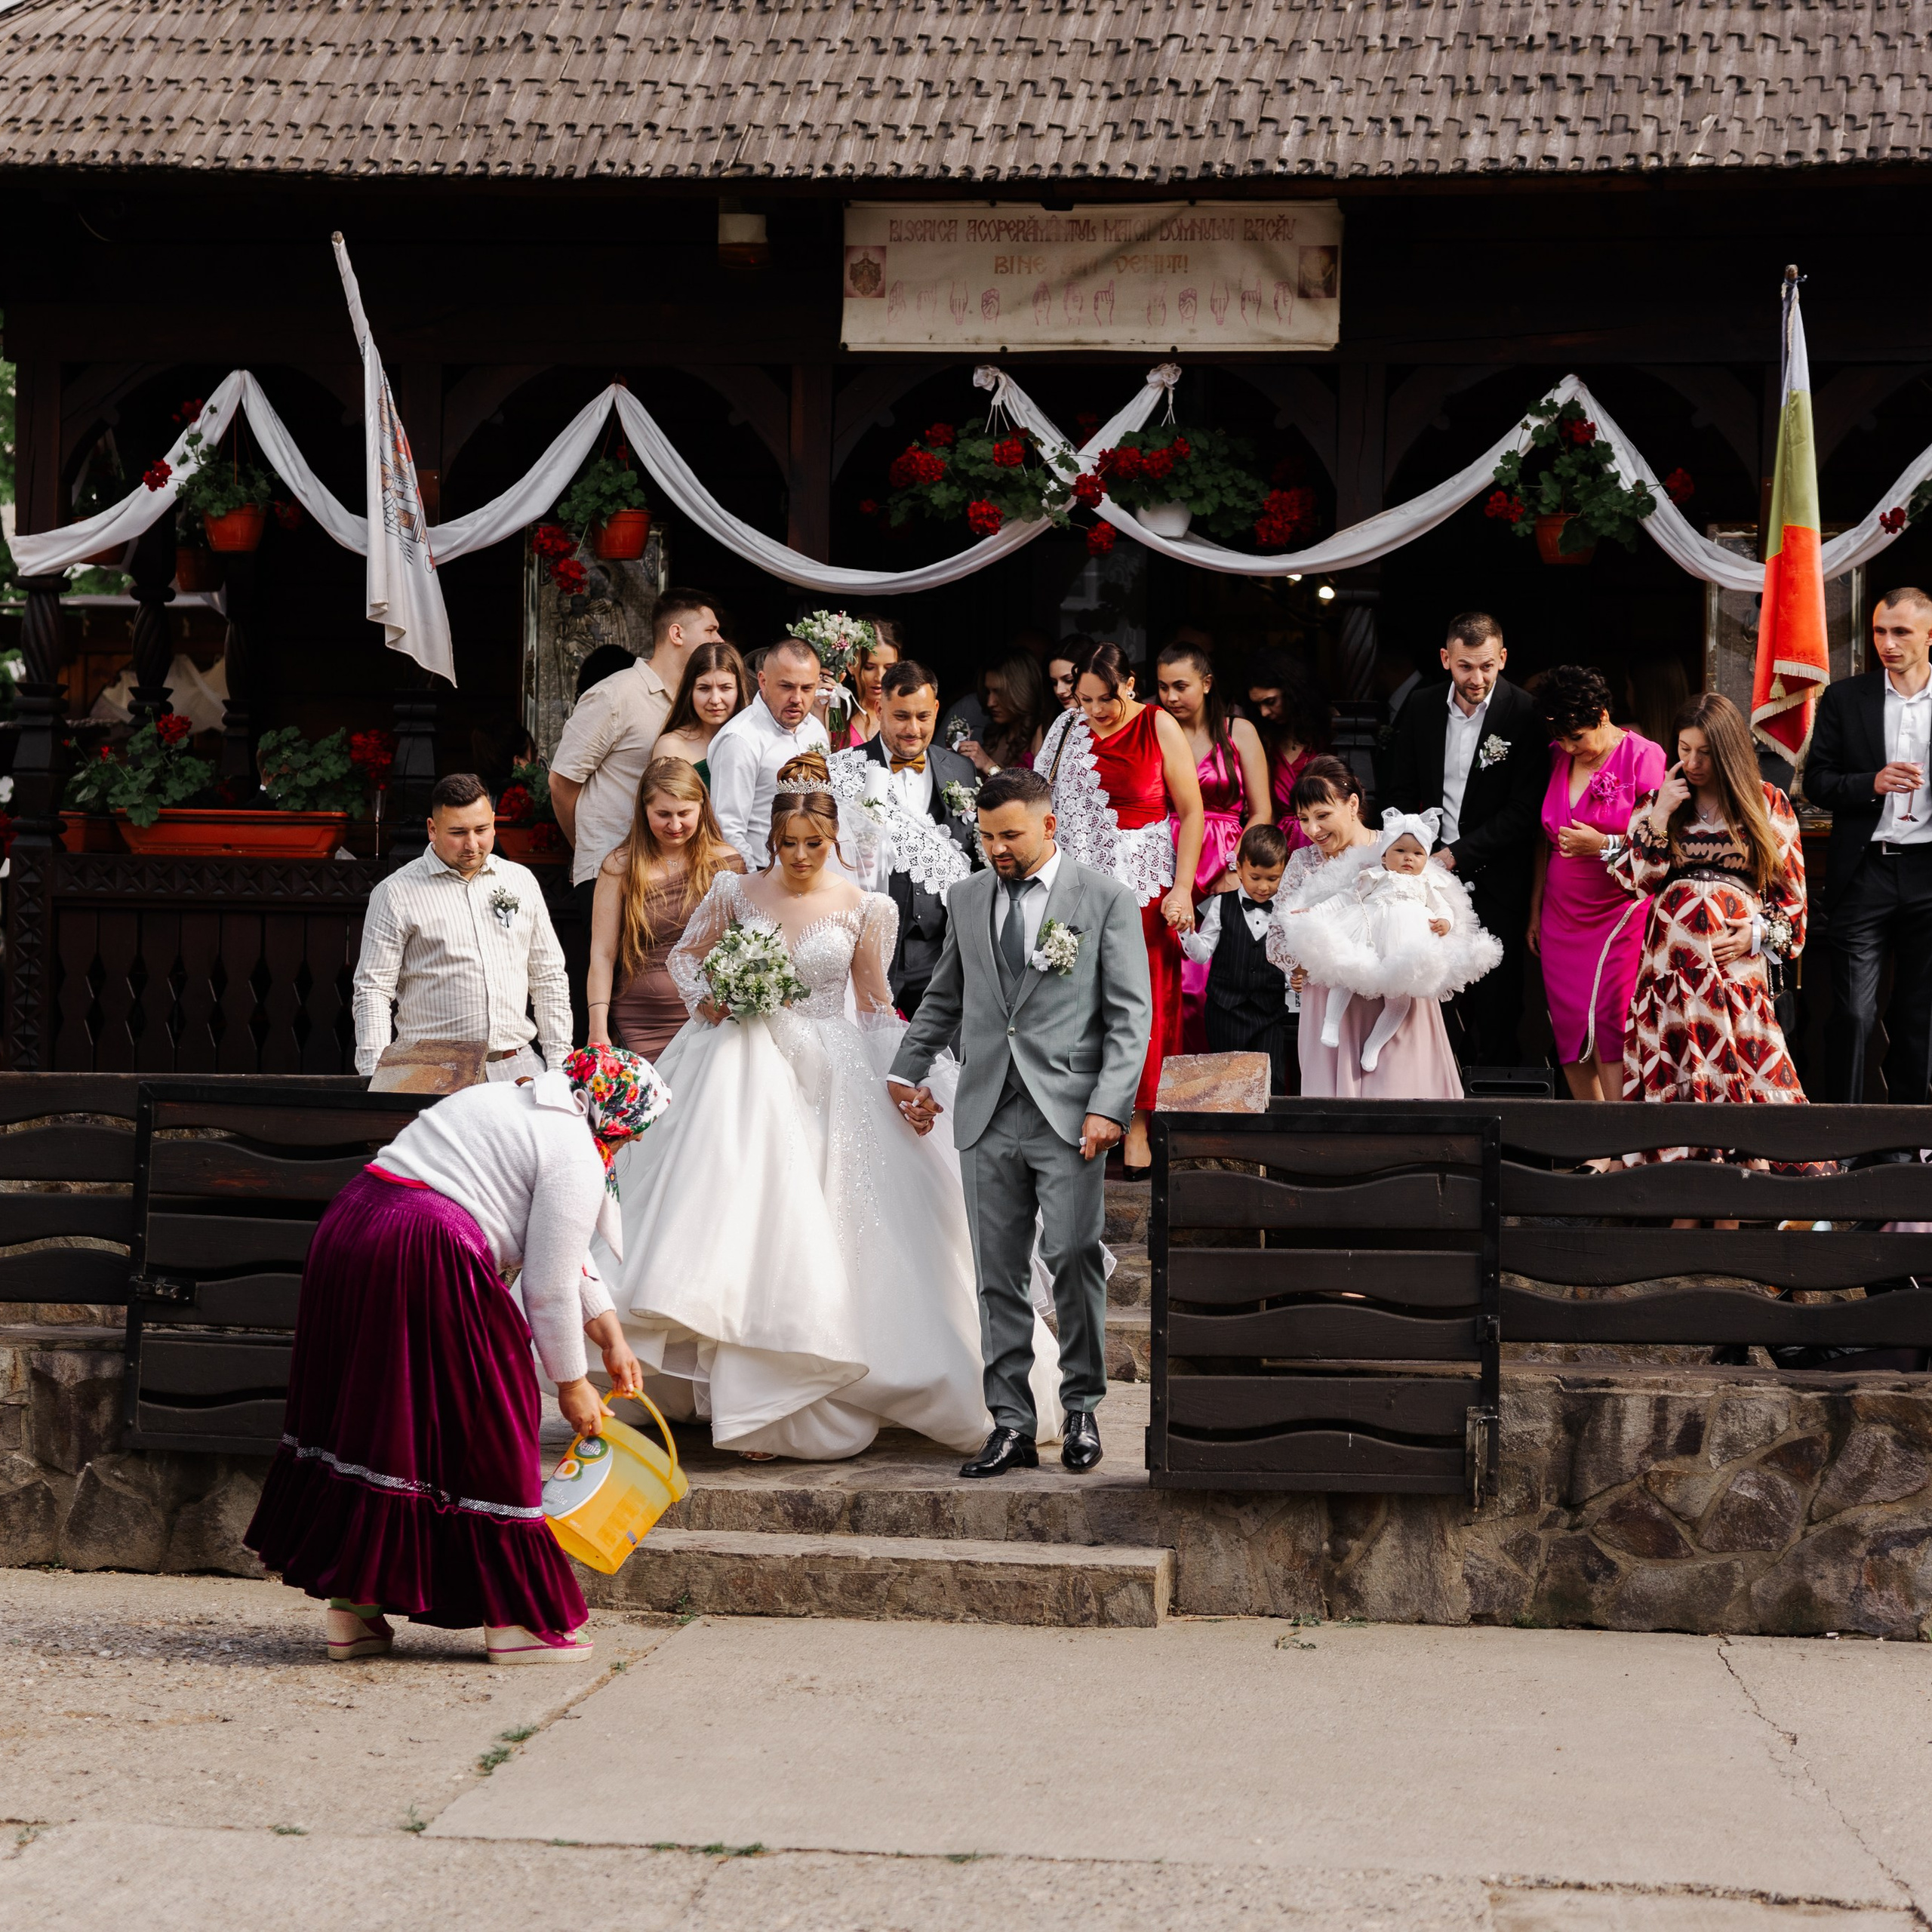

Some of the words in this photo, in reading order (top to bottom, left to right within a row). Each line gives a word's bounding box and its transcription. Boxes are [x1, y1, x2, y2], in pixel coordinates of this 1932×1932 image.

[889, 219, 958, 242] BISERICA
[1159, 218, 1235, 242] DOMNULUI
[1243, 214, 1297, 242] BACĂU
[994, 255, 1048, 275] BINE
[578, 1439, 602, 1456] Remia
